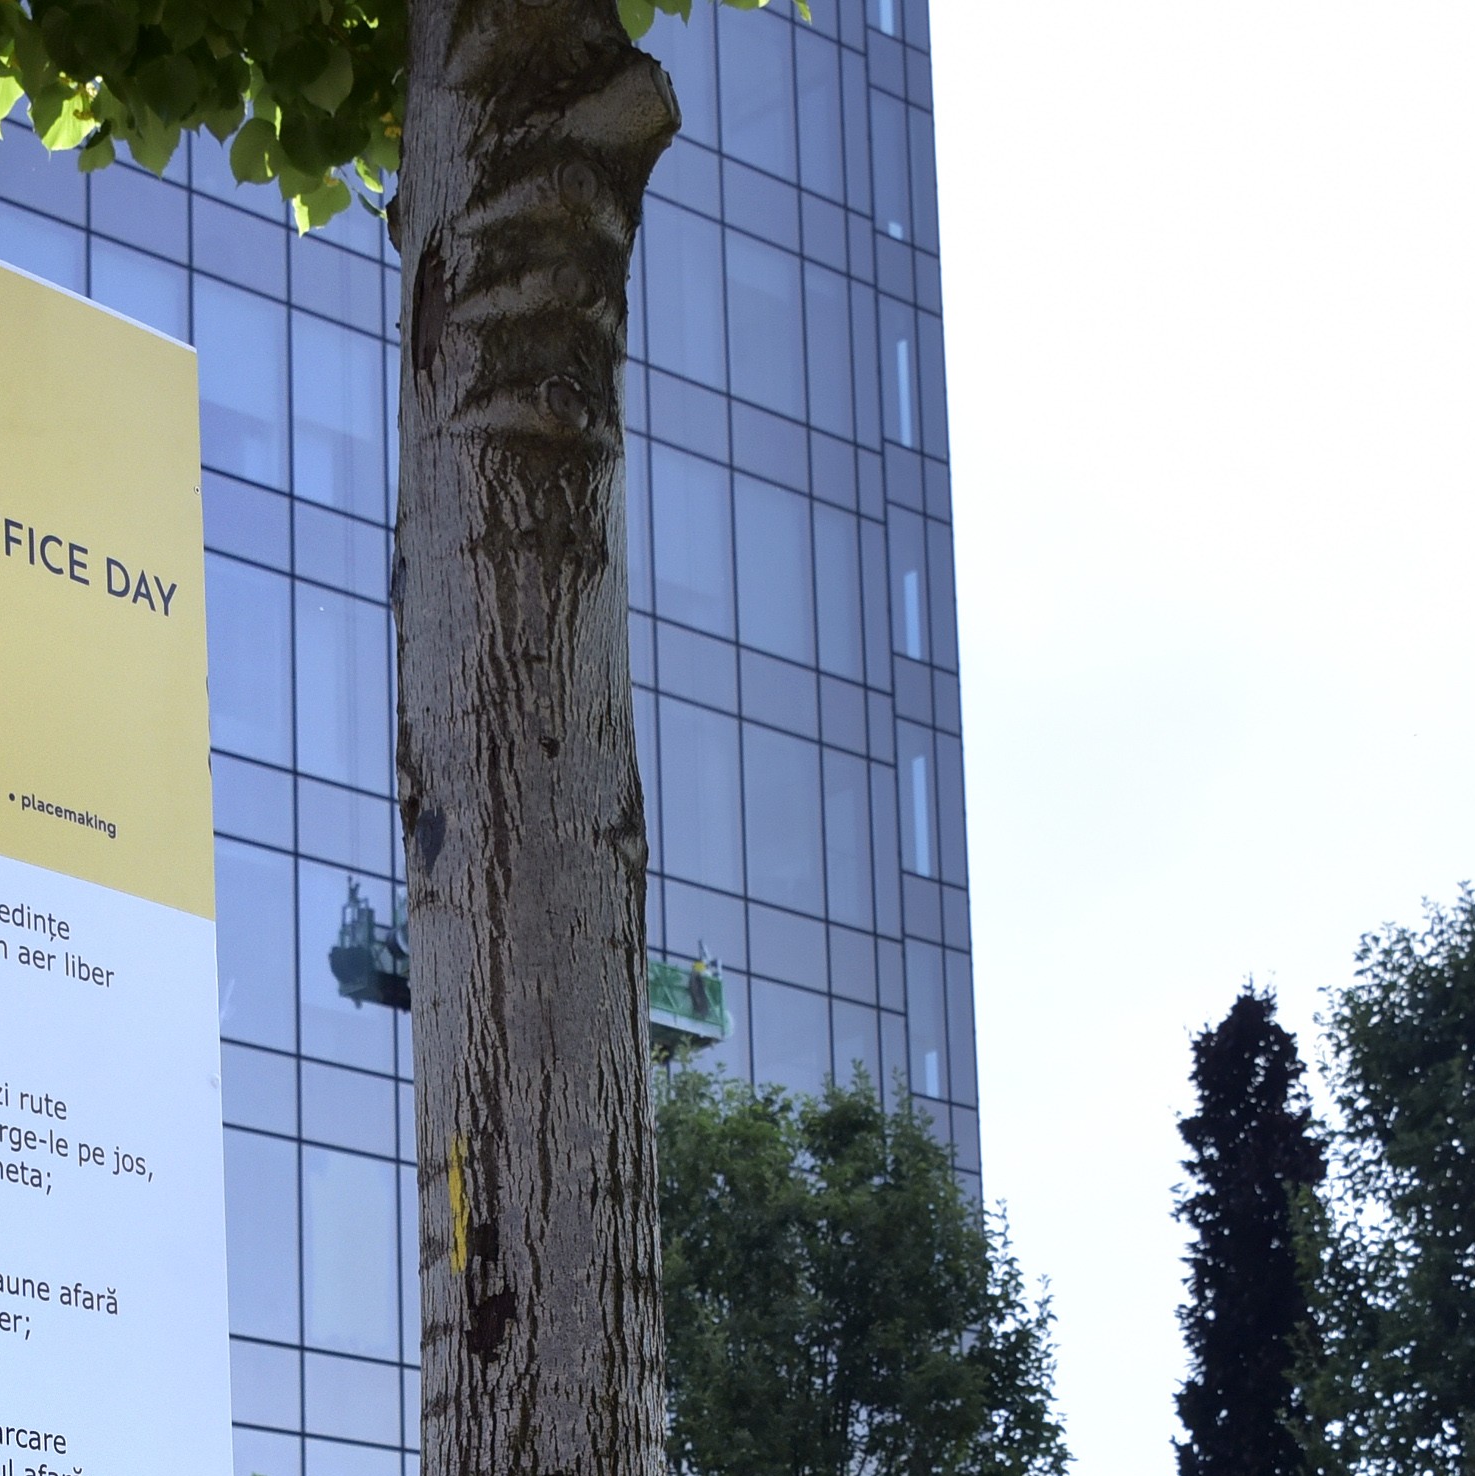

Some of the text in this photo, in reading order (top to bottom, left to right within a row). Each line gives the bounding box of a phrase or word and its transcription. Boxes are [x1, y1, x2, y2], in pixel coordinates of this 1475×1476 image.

[105, 556, 178, 618] DAY
[21, 793, 117, 840] placemaking
[17, 945, 57, 972] aer
[64, 951, 115, 989] liber
[19, 1091, 67, 1121] rute
[78, 1142, 105, 1168] pe
[111, 1145, 154, 1183] jos,
[59, 1282, 118, 1316] afară
